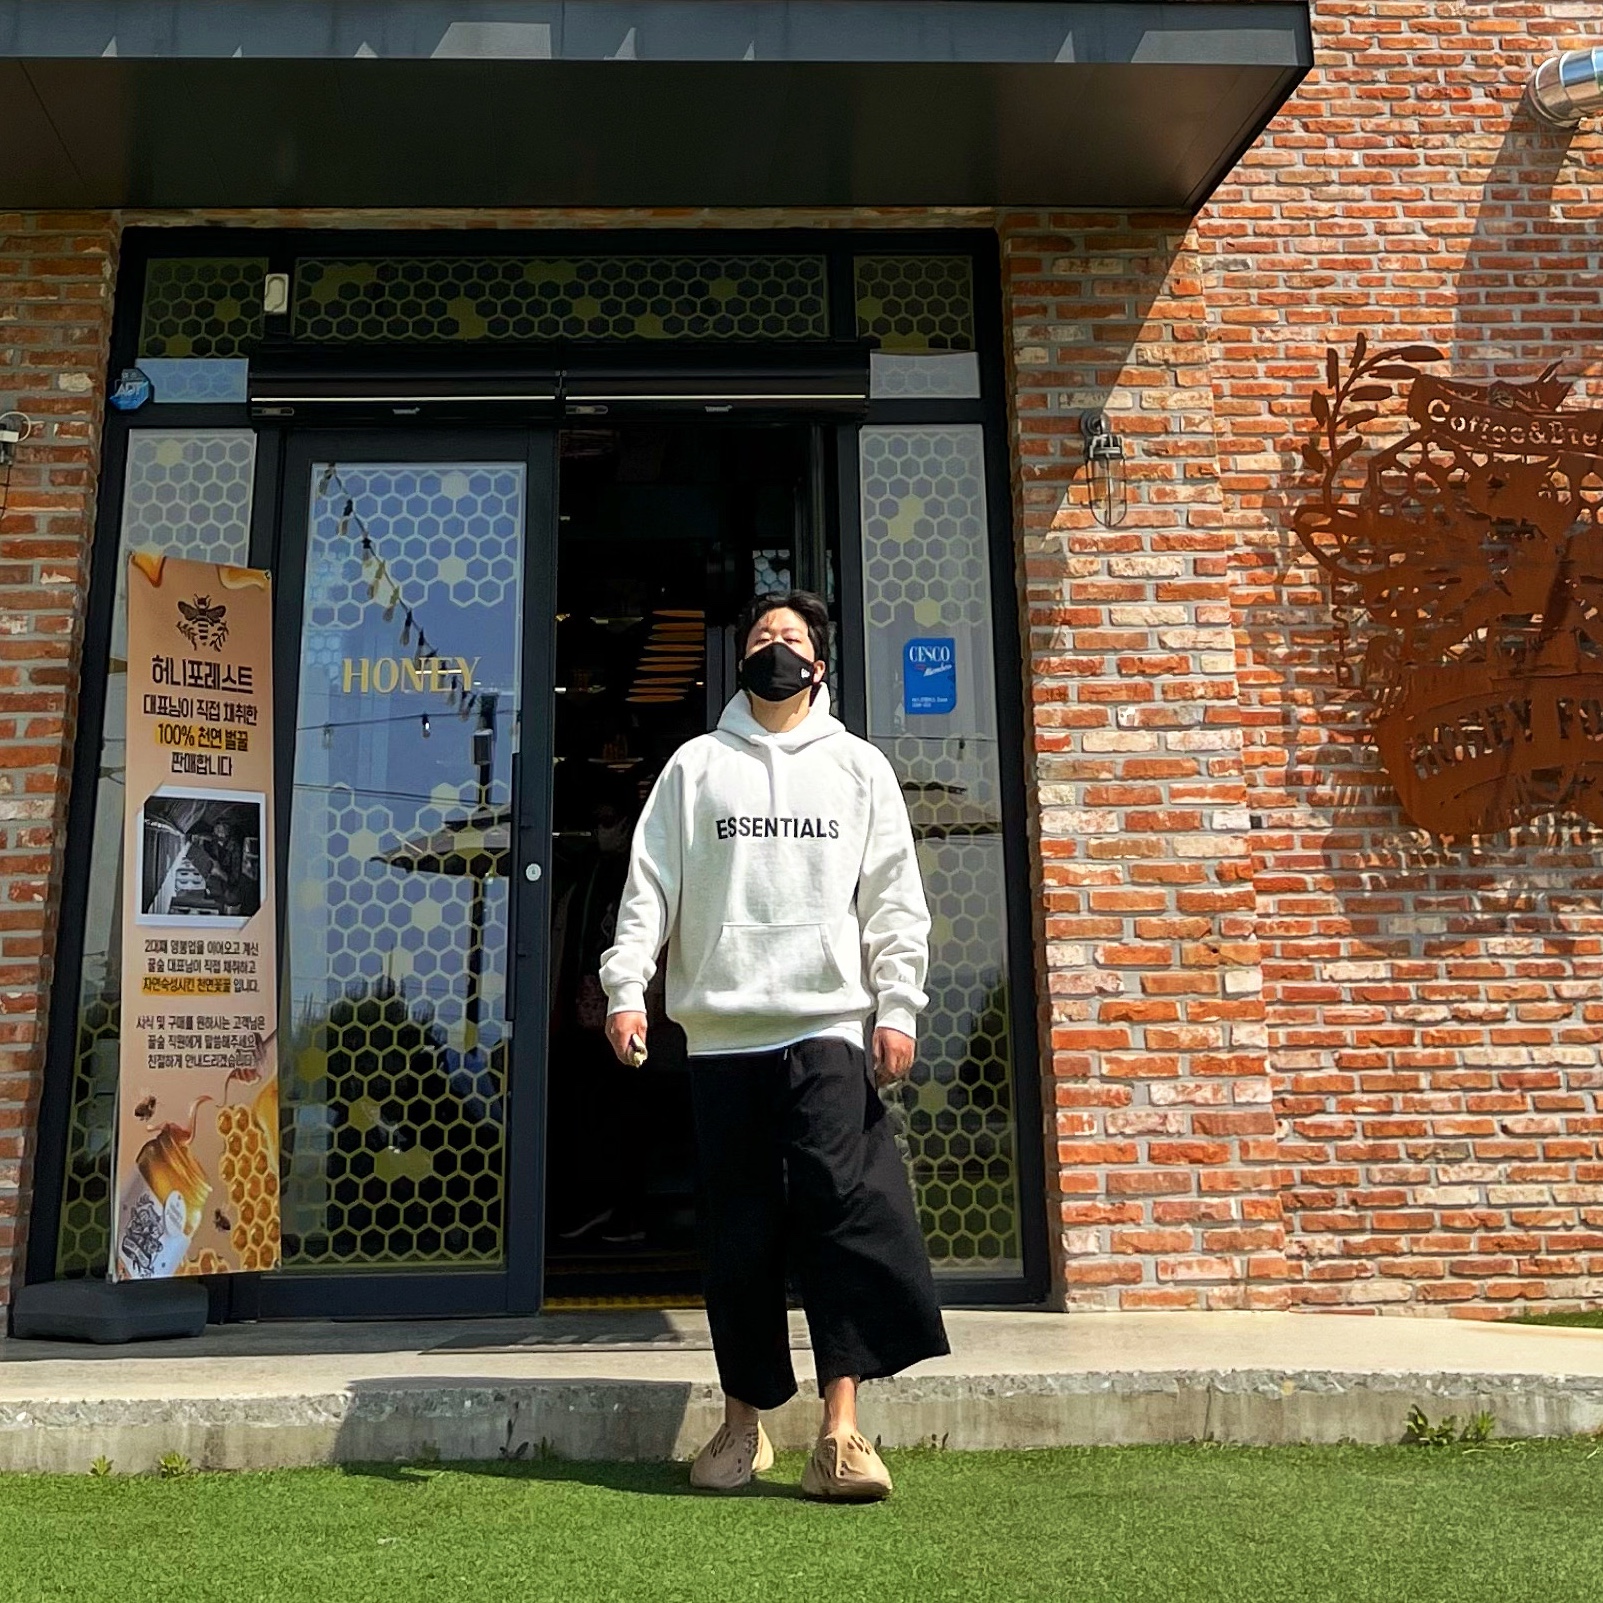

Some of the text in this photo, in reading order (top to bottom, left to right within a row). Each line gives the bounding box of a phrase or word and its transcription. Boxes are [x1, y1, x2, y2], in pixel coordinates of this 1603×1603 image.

[152, 654, 254, 695] 허니포레스트
[342, 656, 482, 695] HONEY
[143, 694, 257, 727] 대표님이 직접 채취한
[157, 723, 248, 752] 100% 천연 벌꿀
[171, 751, 232, 777] 판매합니다
[715, 816, 840, 840] ESSENTIALS
[167, 958, 202, 974] 대표님이
[204, 959, 221, 974] 직접
[156, 1015, 165, 1030] 및
[196, 1015, 231, 1031] 원하시는
[233, 1015, 266, 1031] 고객님은
[148, 1053, 183, 1069] 친절하게
